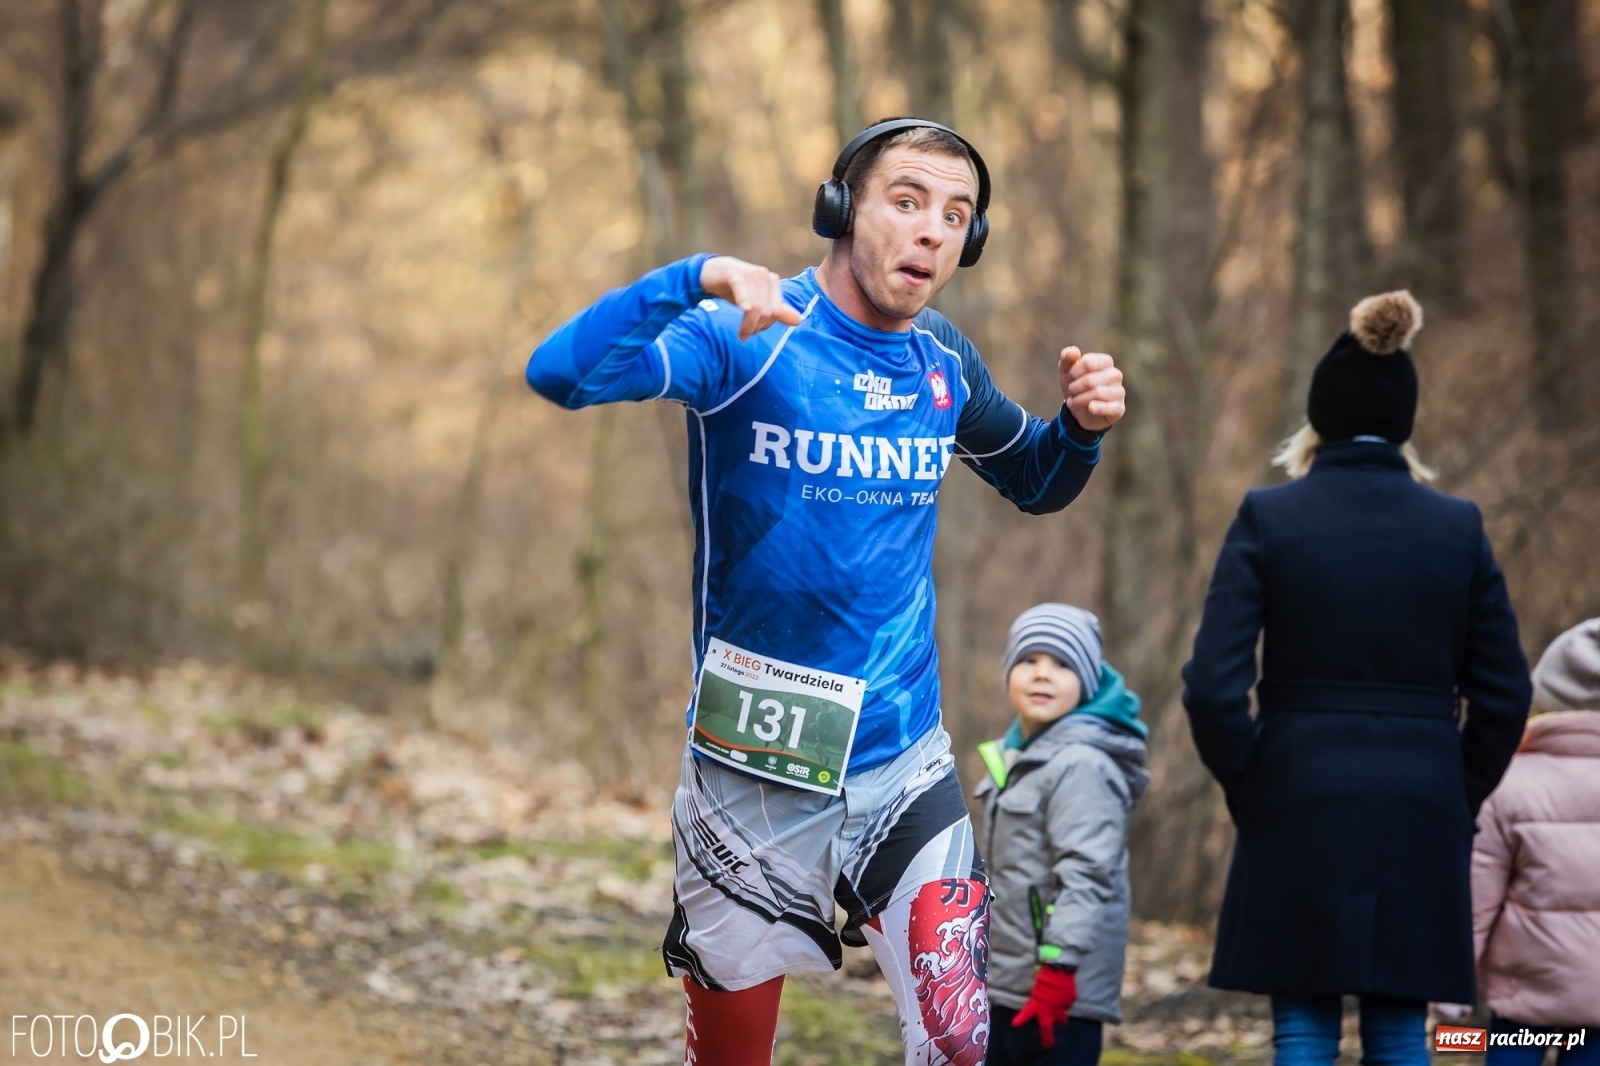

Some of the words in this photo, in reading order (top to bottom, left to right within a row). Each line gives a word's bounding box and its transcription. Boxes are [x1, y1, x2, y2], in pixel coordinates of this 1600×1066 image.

[911, 490, 939, 506] TEA
[723, 649, 732, 660] X
[733, 653, 762, 671] BIEG
[764, 663, 844, 692] Twardziela
[727, 665, 745, 676] lutego
[745, 671, 759, 680] 2022
[736, 689, 807, 749] 131
